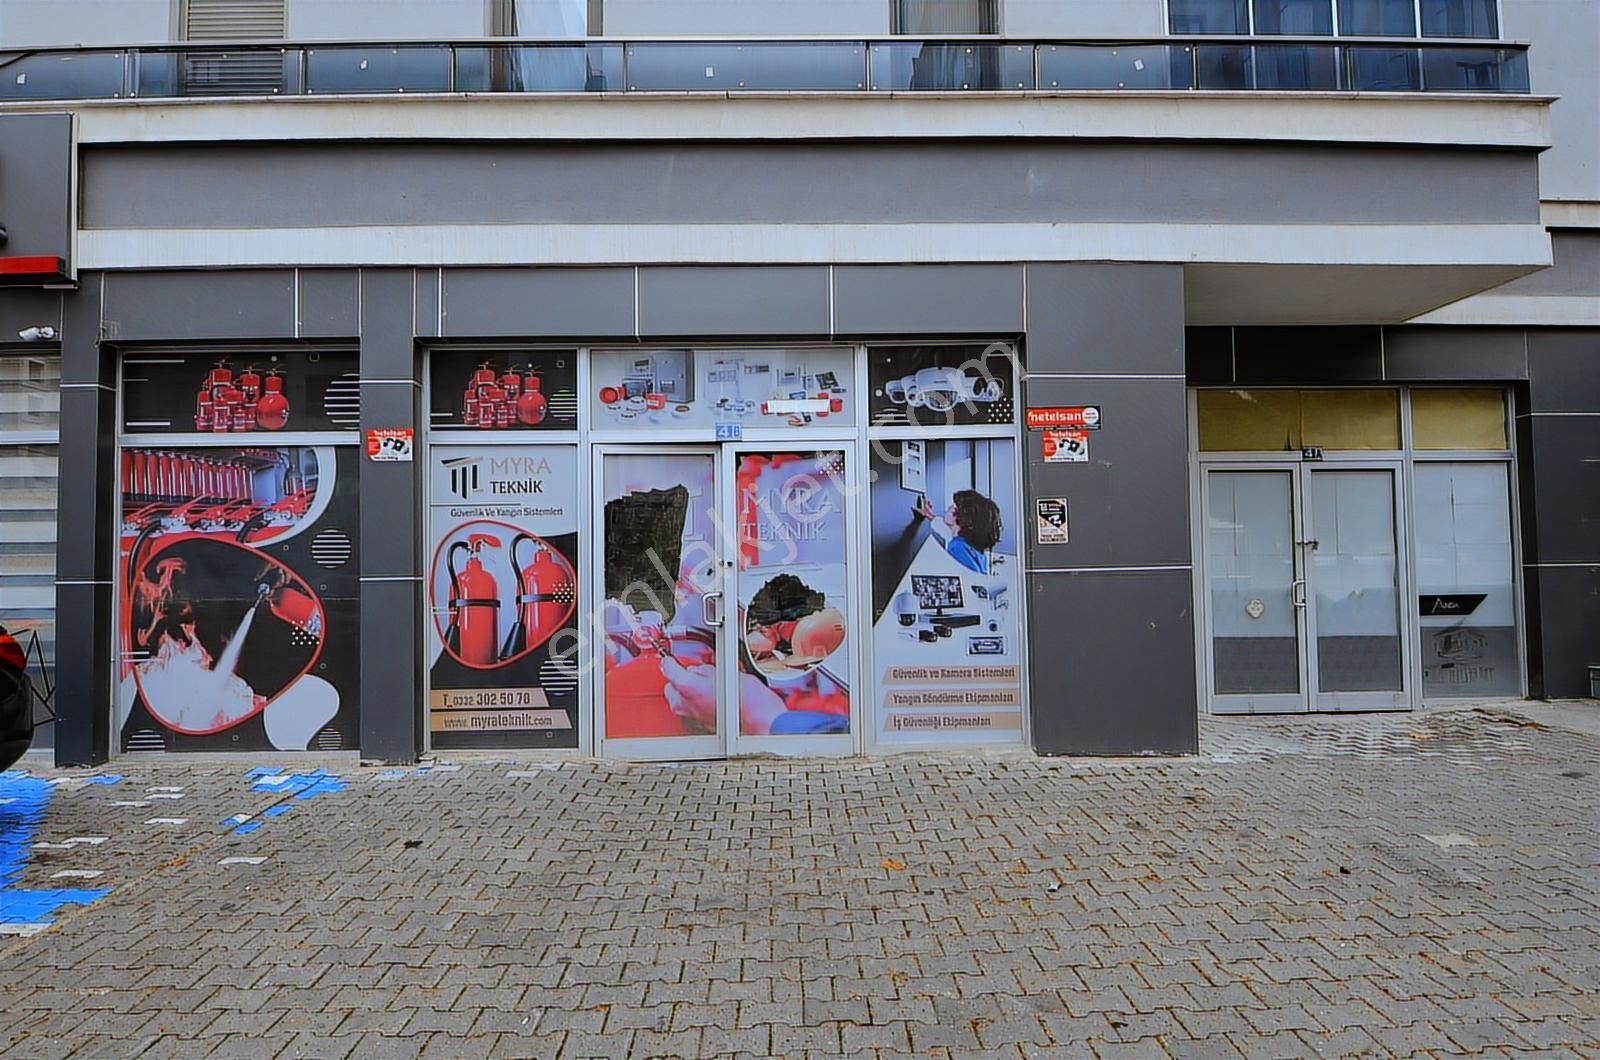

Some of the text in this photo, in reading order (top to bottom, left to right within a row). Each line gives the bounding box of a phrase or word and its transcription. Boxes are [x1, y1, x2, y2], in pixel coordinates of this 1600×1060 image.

[490, 457, 552, 474] MYRA
[490, 478, 543, 494] TEKNİK
[893, 666, 1015, 678] Güvenlik ve Kamera Sistemleri
[477, 692, 497, 706] 302
[500, 692, 514, 706] 50
